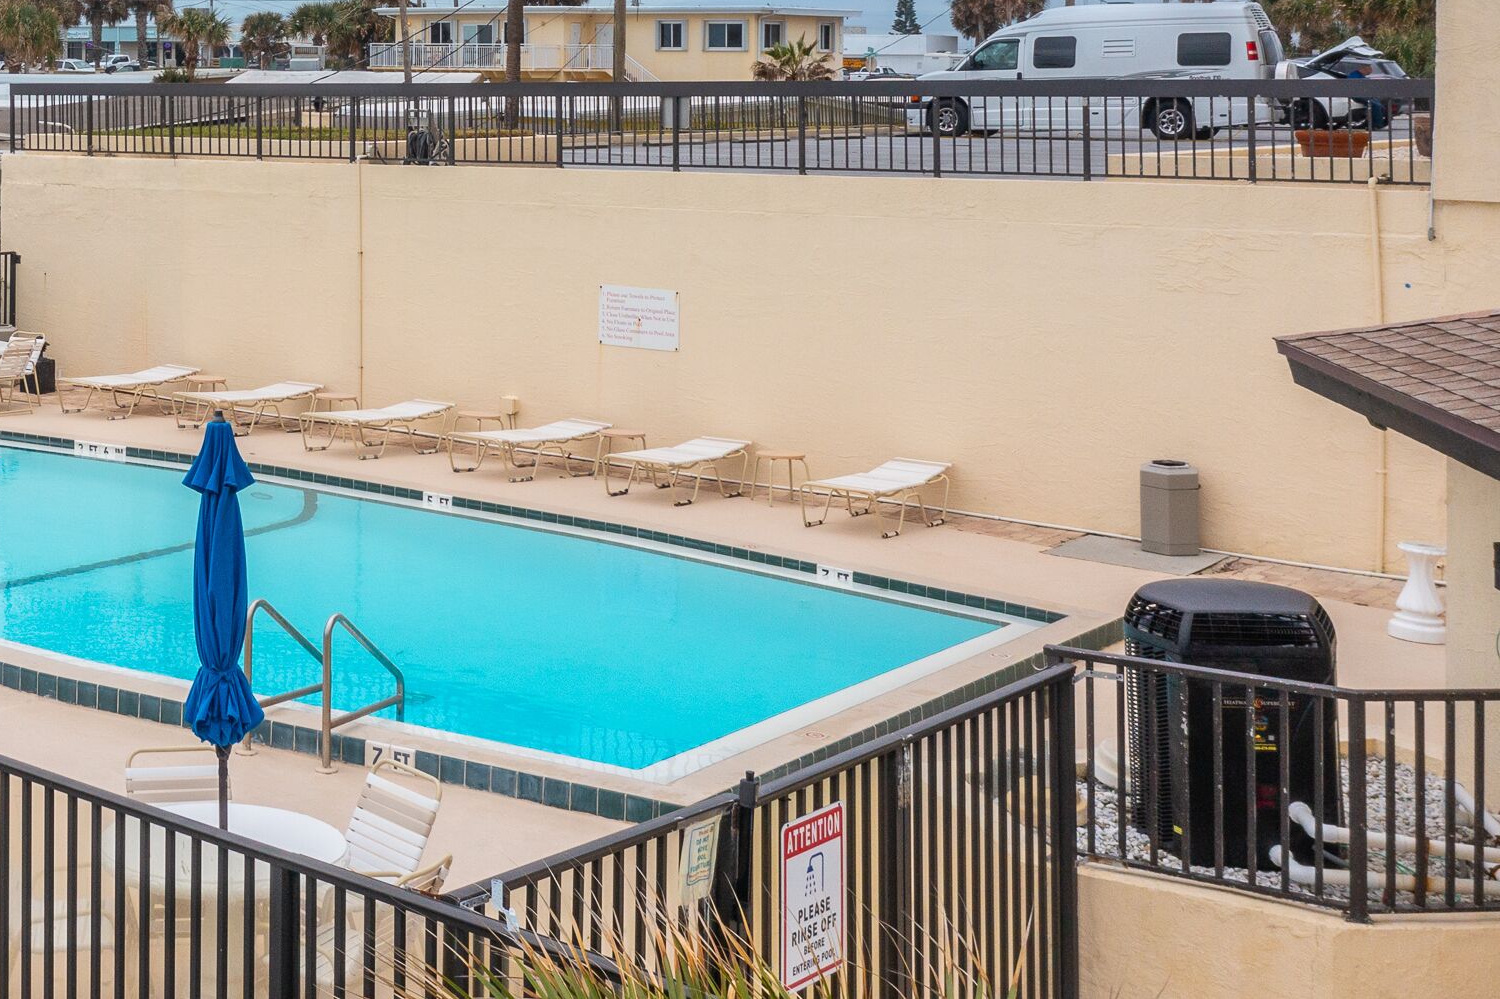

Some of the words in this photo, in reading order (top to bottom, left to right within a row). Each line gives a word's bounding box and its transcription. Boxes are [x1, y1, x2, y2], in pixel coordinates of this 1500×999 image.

[372, 746, 382, 765] 7
[393, 750, 410, 770] FT
[787, 811, 840, 854] ATTENTION
[798, 896, 831, 924] PLEASE
[791, 921, 818, 947] RINSE
[820, 912, 837, 933] OFF
[803, 937, 825, 956] BEFORE
